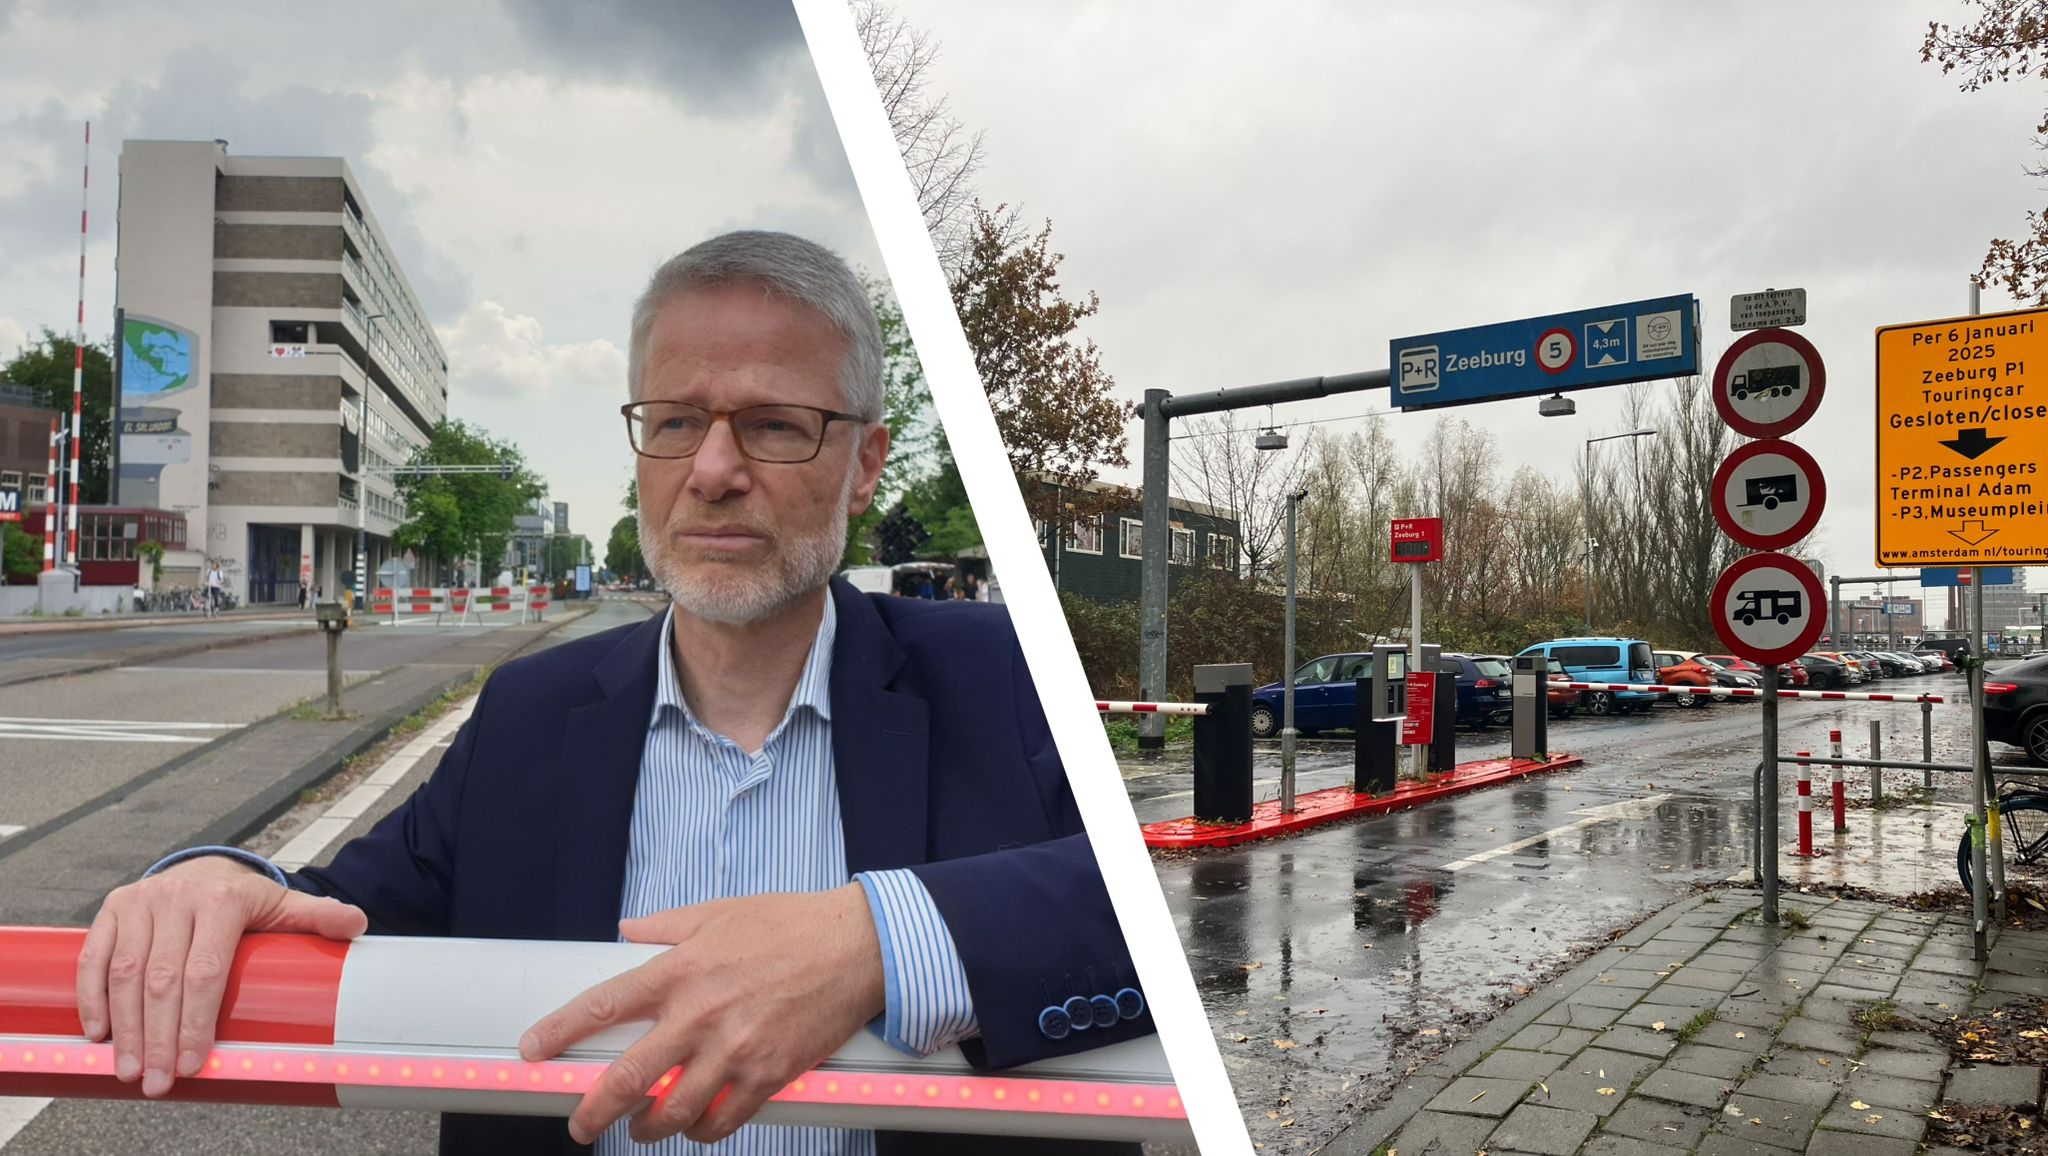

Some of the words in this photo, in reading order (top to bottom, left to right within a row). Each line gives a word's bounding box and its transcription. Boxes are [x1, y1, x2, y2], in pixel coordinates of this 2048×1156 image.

[1766, 290, 1793, 299] terrein
[1755, 308, 1796, 319] toepassing
[1785, 316, 1804, 324] 2.20
[1912, 332, 1942, 346] Per
[1948, 328, 1959, 342] 6
[1965, 319, 2034, 345] januari
[1550, 341, 1562, 359] 5
[1948, 344, 1996, 362] 2025
[1401, 358, 1438, 382] P+R
[1445, 348, 1526, 373] Zeeburg
[1922, 366, 1997, 384] Zeeburg
[2006, 361, 2024, 377] P1
[1922, 384, 2024, 404] Touringcar
[1889, 405, 2048, 429] Gesloten/close
[1890, 483, 1971, 500] Terminal
[1978, 482, 2032, 497] Adam
[1394, 531, 1420, 539] Zeeburg
